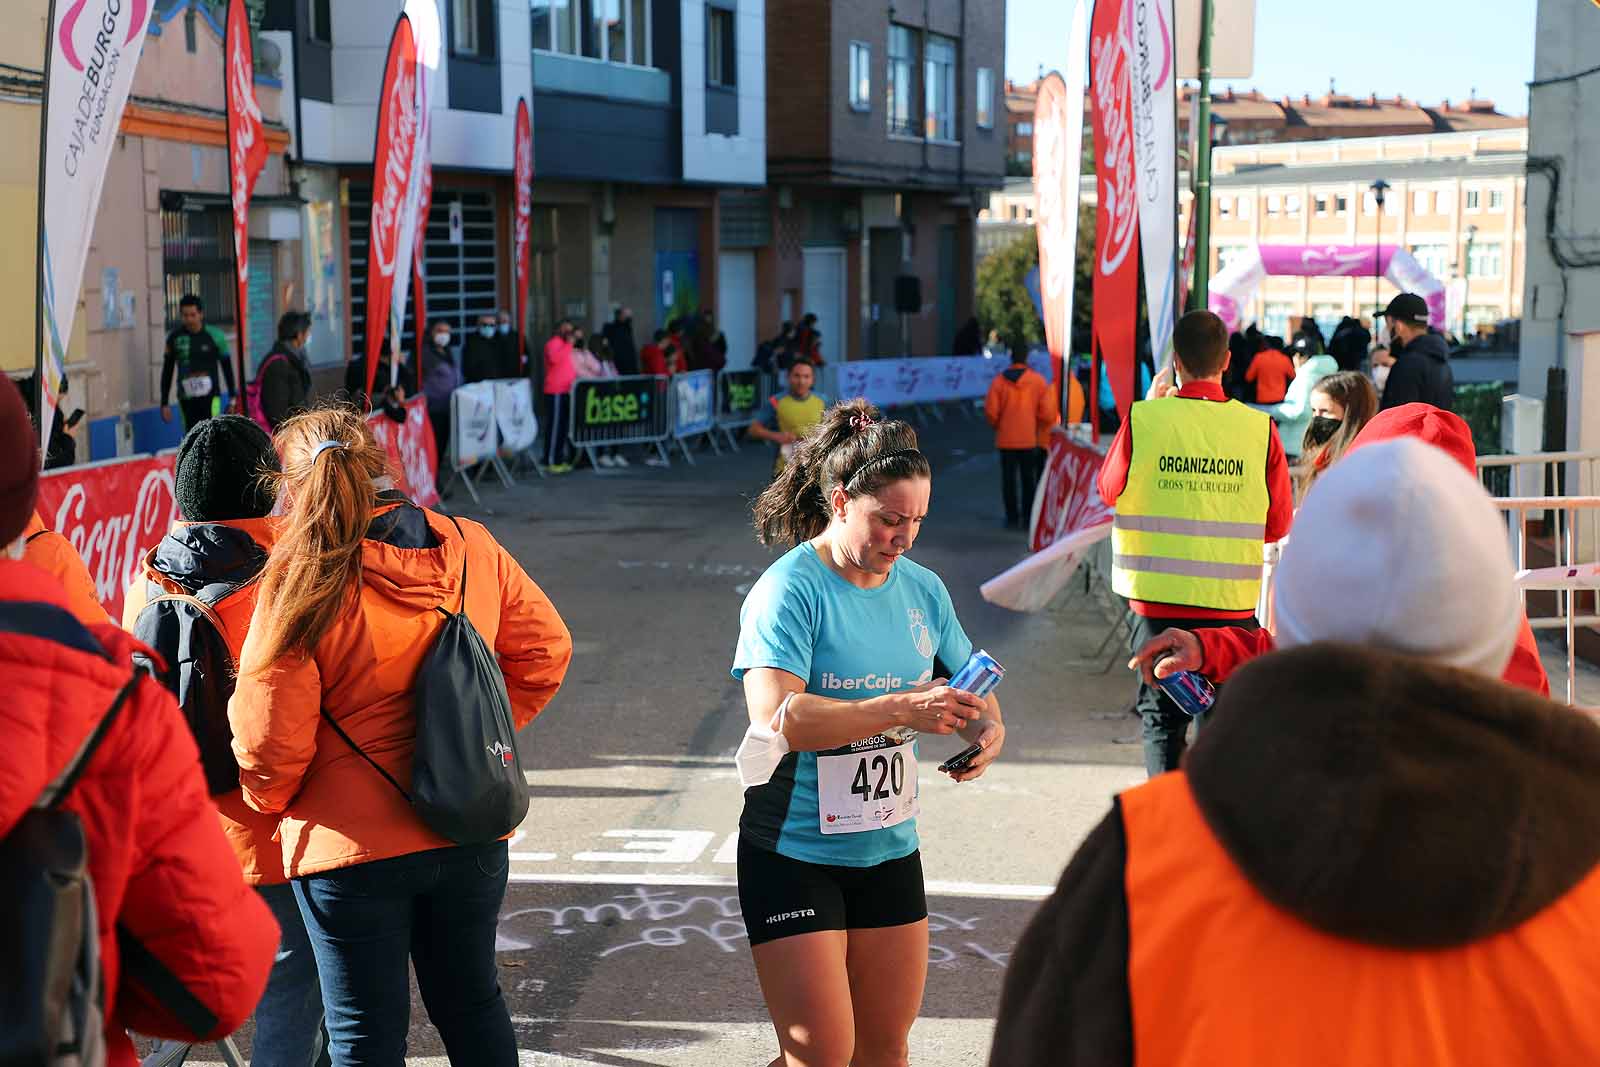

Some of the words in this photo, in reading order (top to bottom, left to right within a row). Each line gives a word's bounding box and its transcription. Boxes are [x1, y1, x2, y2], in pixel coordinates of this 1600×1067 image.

[1159, 455, 1244, 476] ORGANIZACION
[1158, 479, 1184, 489] CROSS
[822, 672, 902, 692] iberCaja
[851, 752, 904, 801] 420
